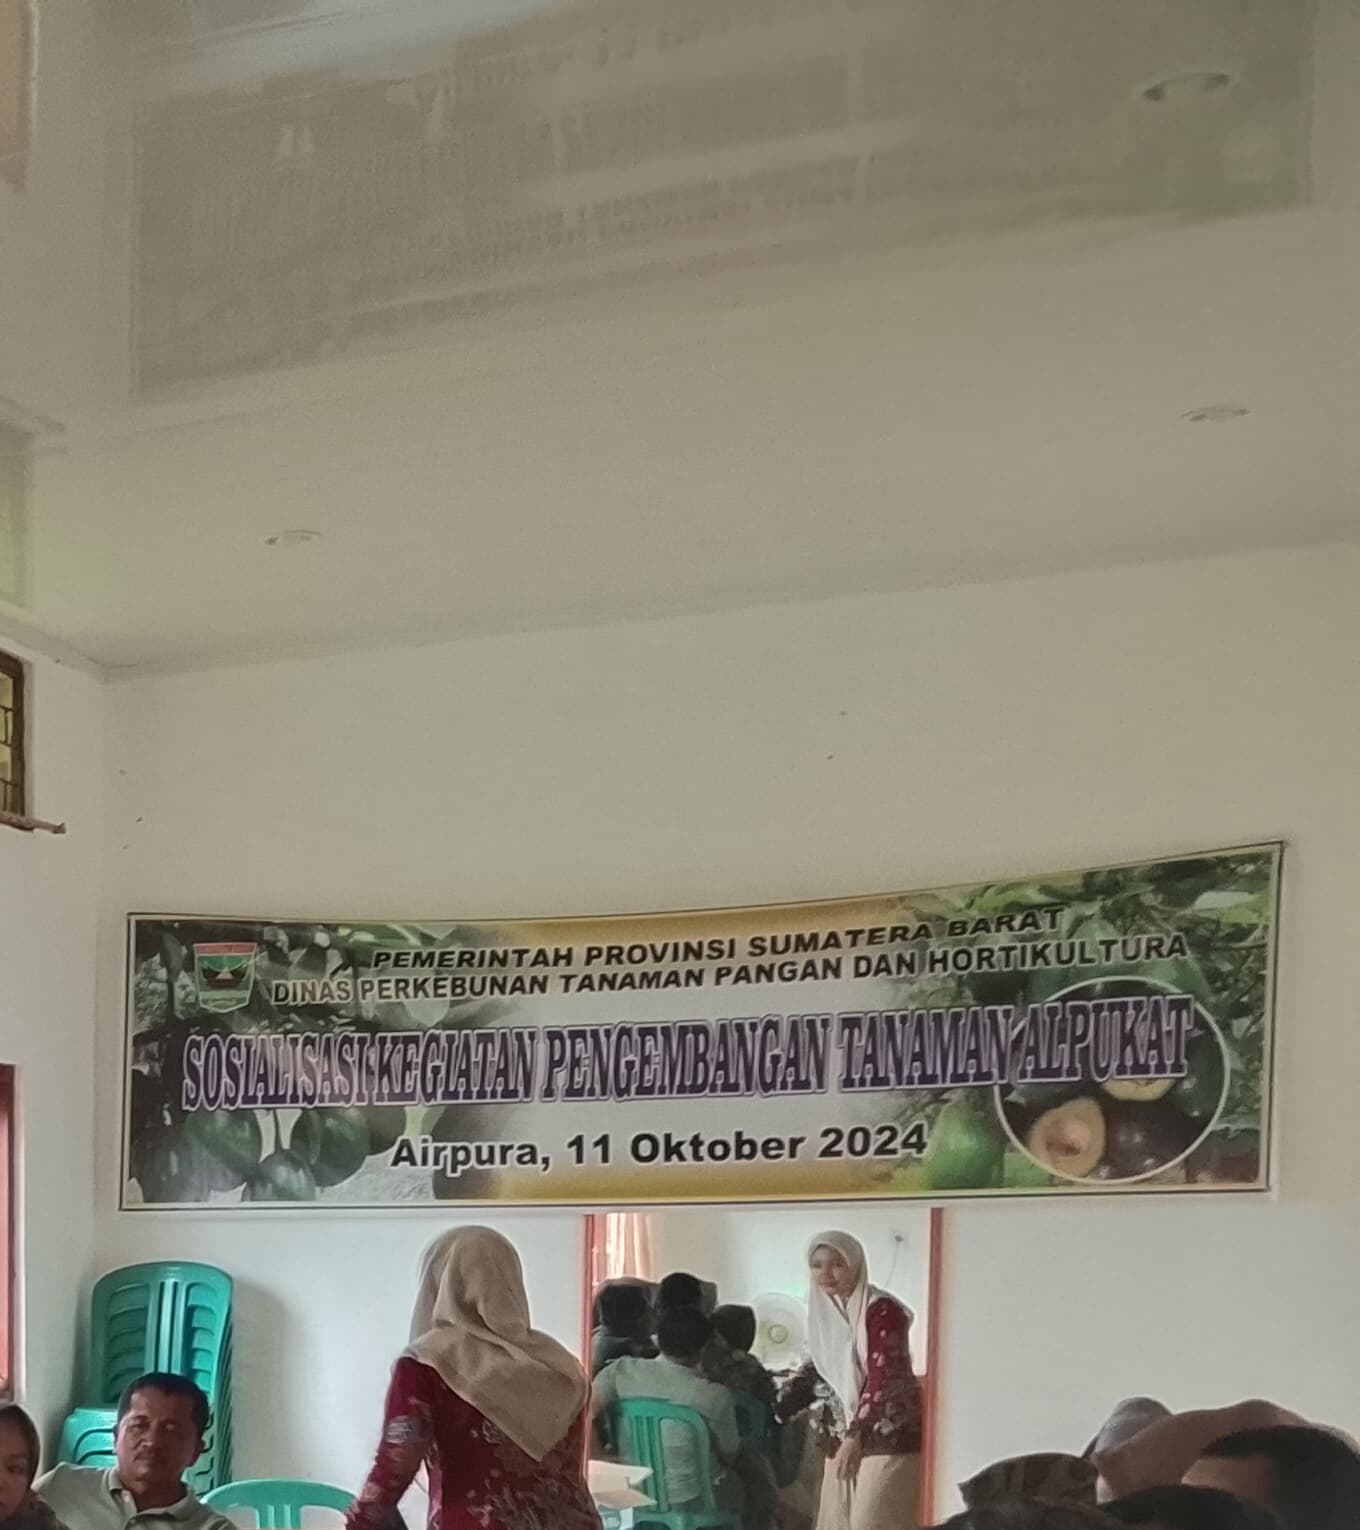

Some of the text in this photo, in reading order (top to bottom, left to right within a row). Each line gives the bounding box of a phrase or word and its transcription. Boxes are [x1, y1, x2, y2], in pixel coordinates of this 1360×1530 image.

[271, 934, 1189, 1006] DINAS PERKEBUNAN TANAMAN PANGAN DAN HORTIKULTURA
[371, 907, 1066, 971] PEMERINTAH PROVINSI SUMATERA BARAT
[183, 995, 1195, 1111] SOSIALISASI KEGIATAN PENGEMBANGAN TANAMAN ALPUKAT
[390, 1123, 928, 1176] Airpura, 11 Oktober 2024
